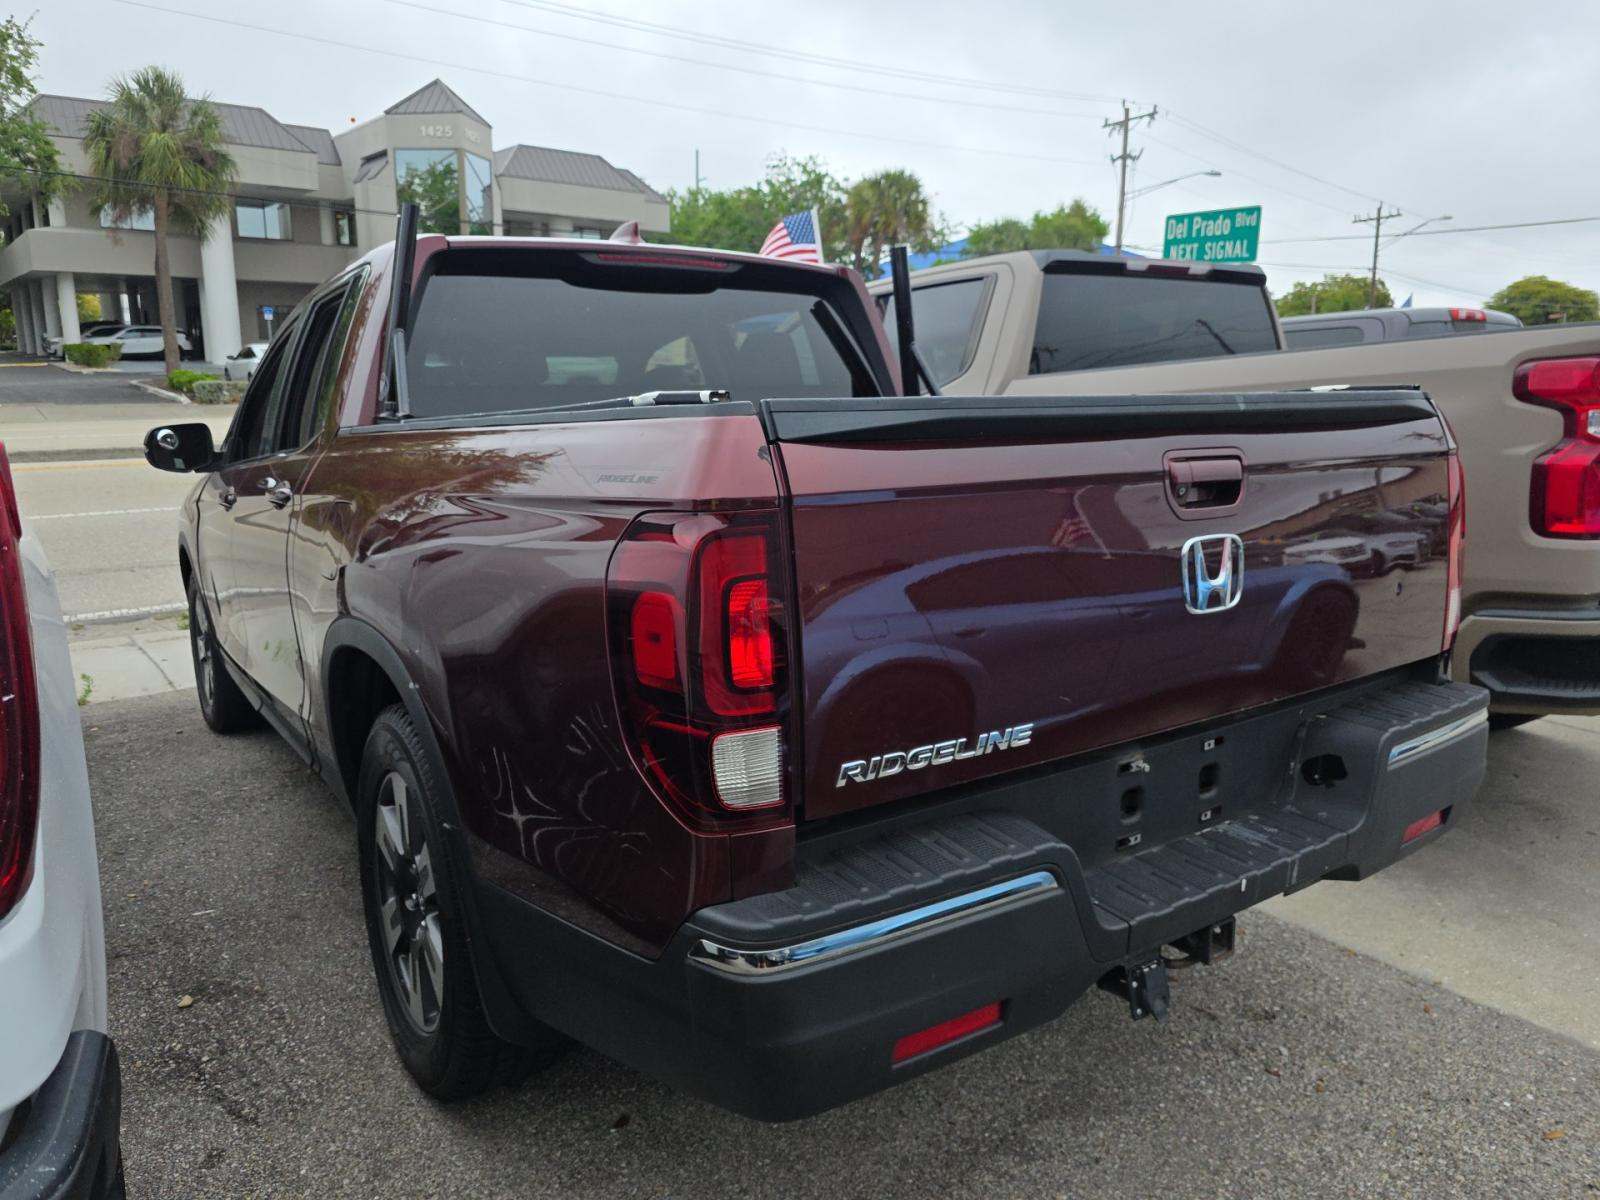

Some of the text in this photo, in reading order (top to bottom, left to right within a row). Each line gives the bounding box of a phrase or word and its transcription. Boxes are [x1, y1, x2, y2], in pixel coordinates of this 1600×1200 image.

[419, 125, 452, 137] 1425
[1167, 211, 1257, 239] Del Prado Blvd
[1169, 240, 1249, 261] NEXT SIGNAL
[836, 723, 1034, 788] RIDGELINE
